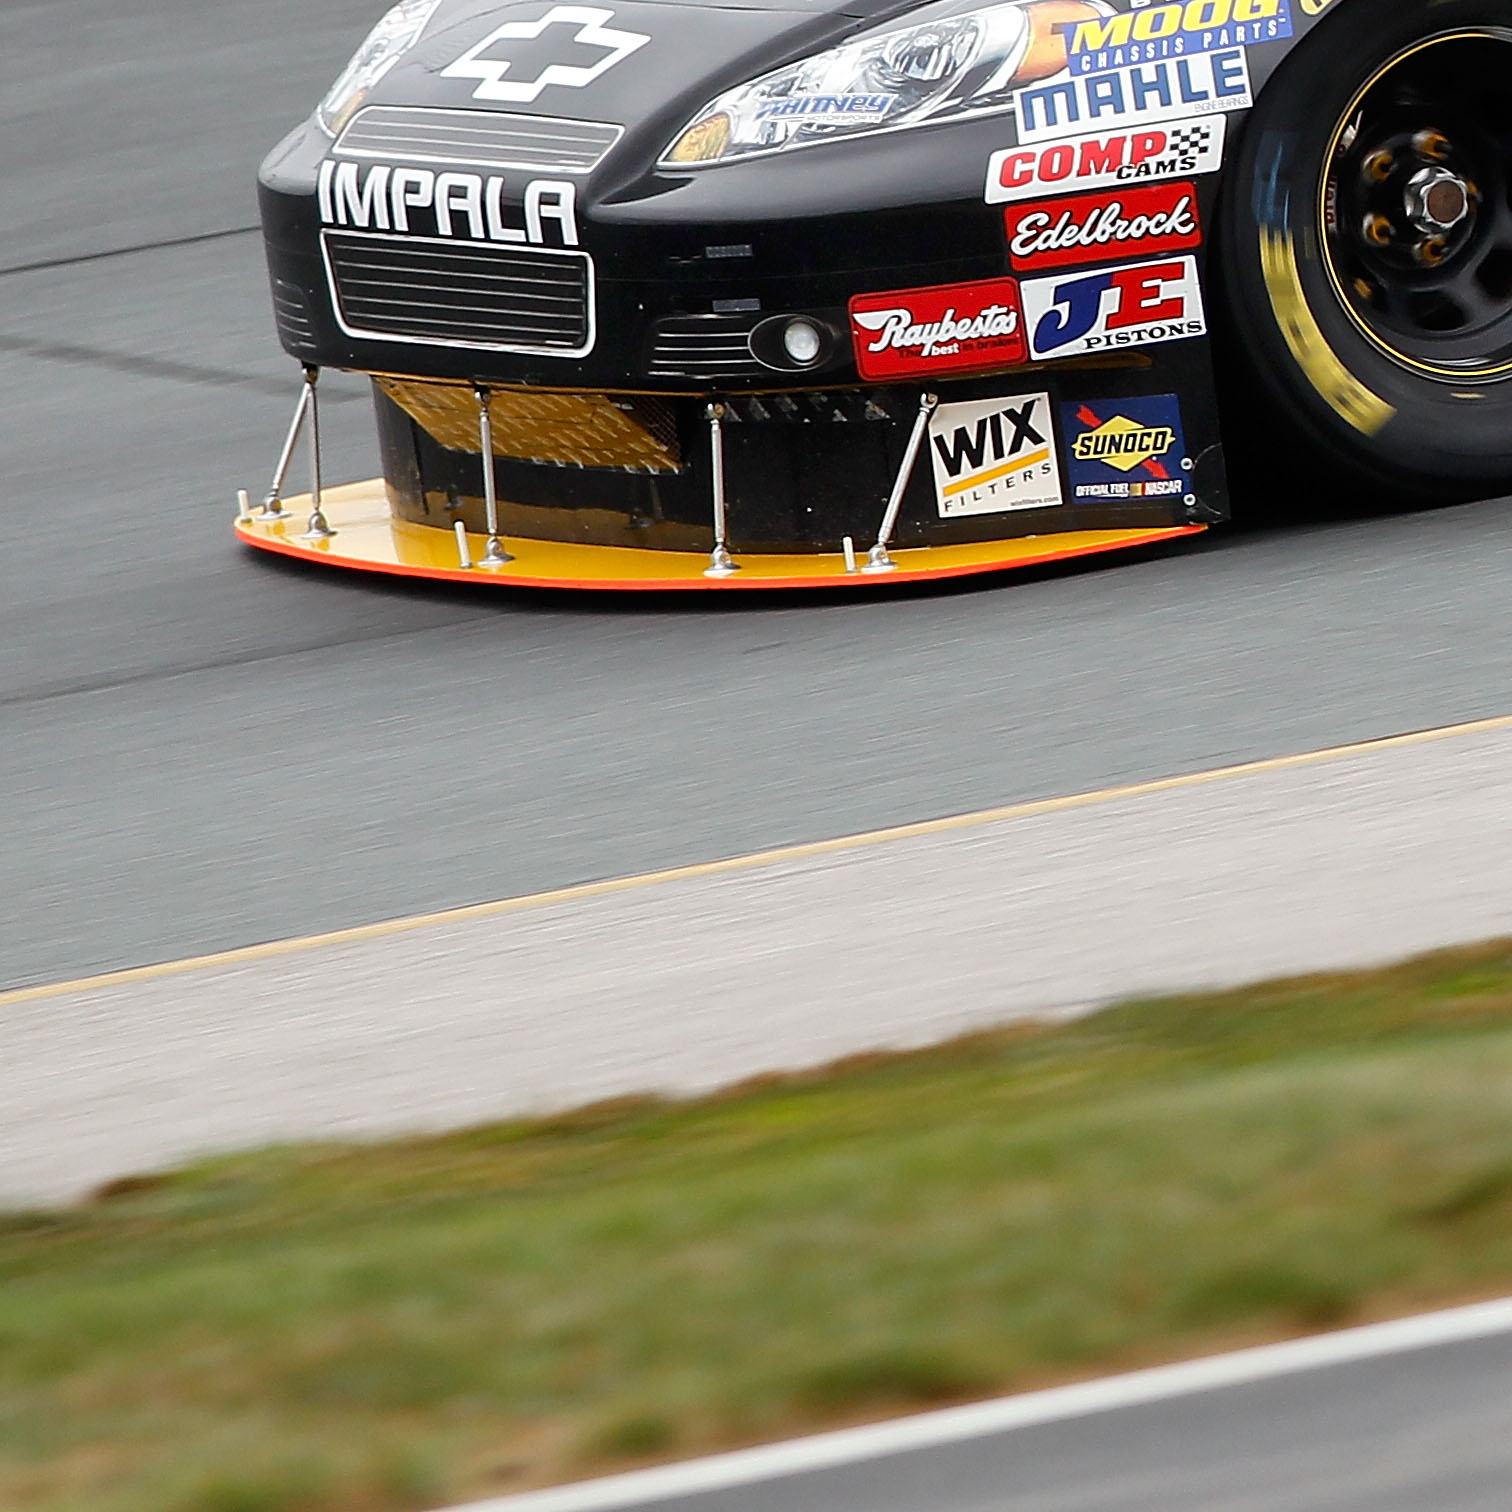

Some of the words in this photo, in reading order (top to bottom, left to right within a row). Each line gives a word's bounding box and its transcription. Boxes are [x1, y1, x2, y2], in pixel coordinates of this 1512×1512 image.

[1081, 37, 1184, 71] CHASSIS
[1203, 19, 1278, 49] PARTS
[1020, 50, 1246, 132] MAHLE
[999, 131, 1167, 188] COMP
[1116, 156, 1197, 180] CAMS
[317, 160, 580, 246] IMPALA
[1010, 195, 1195, 256] Edelbrock
[853, 304, 1018, 356] Raybestos
[1033, 261, 1186, 354] JE
[931, 342, 960, 357] best
[1083, 320, 1204, 350] PISTONS
[933, 399, 1046, 478] WIX
[1078, 430, 1166, 457] SUNOCO
[943, 462, 1051, 513] FILTERS
[1076, 484, 1109, 496] OFFICIAL
[1110, 482, 1129, 494] FUEL
[1144, 480, 1183, 496] NASCAR
